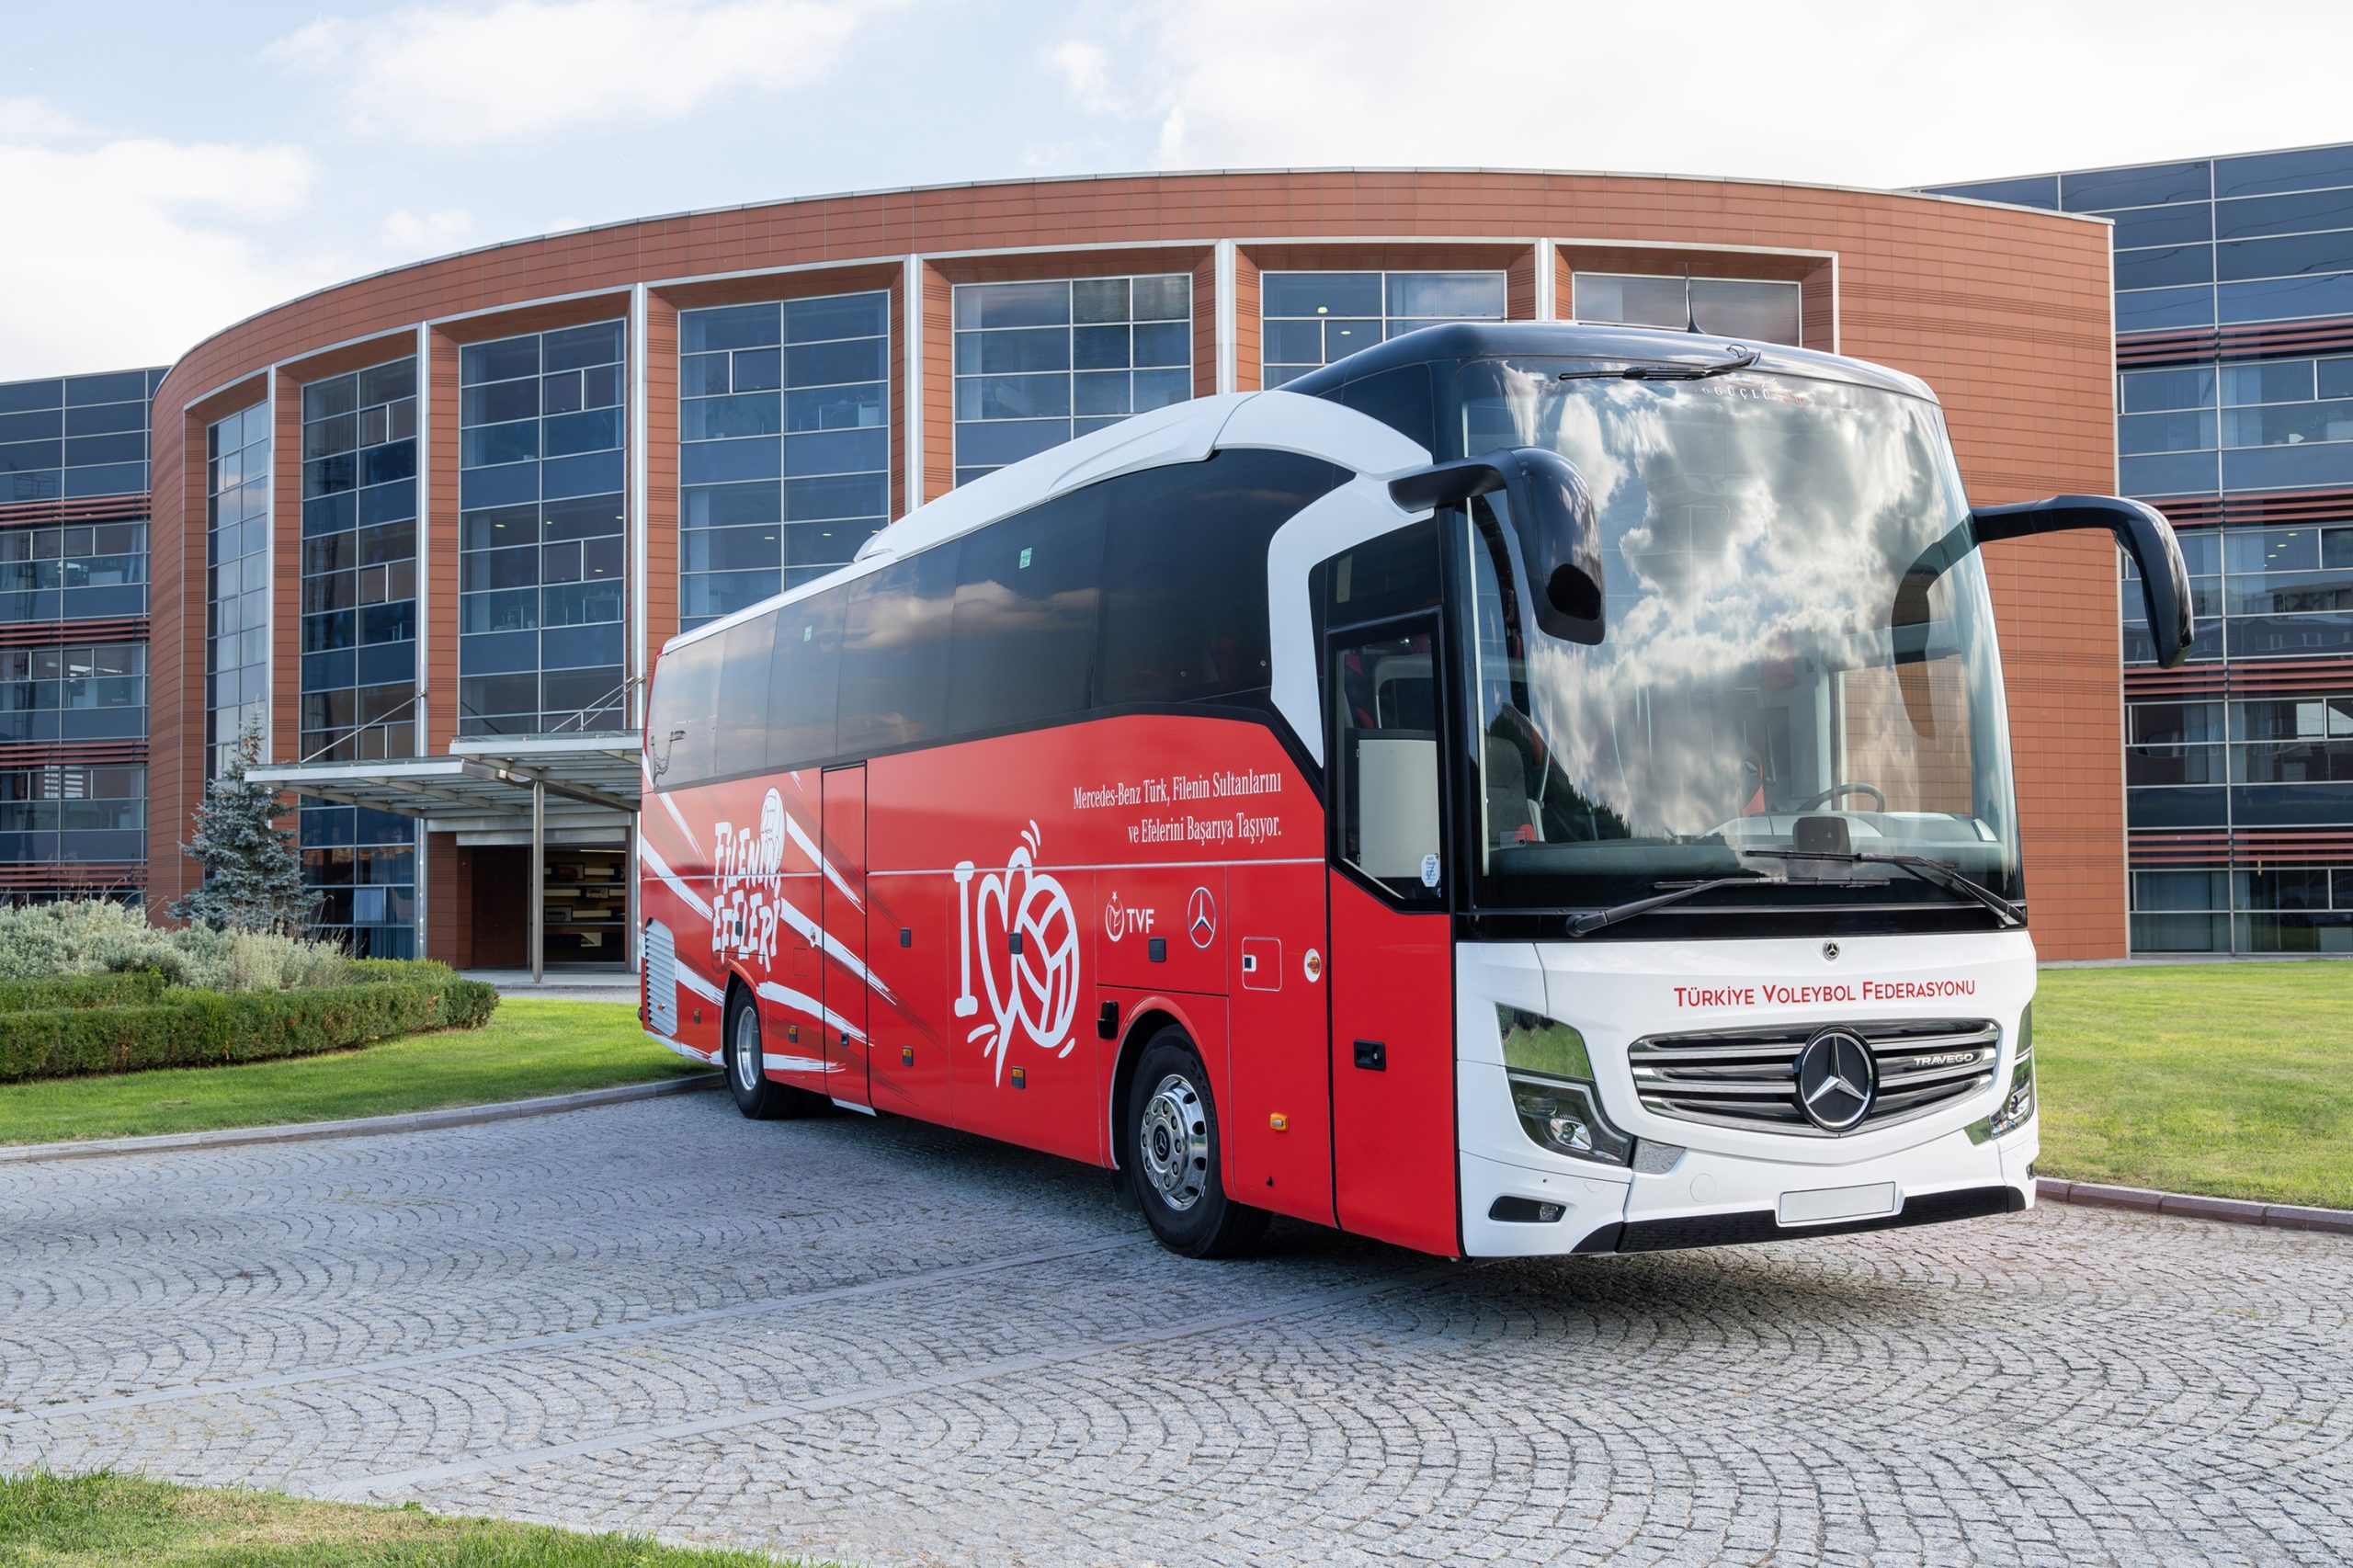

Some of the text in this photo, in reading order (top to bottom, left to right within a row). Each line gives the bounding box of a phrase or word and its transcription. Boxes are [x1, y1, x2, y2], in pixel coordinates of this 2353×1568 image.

[1074, 768, 1281, 809] Mercedes-Benz Türk, Filenin Sultanlarını
[1128, 812, 1281, 846] ve Efelerini Başarıya Taşıyor.
[1126, 908, 1154, 934] TVF
[1674, 980, 1975, 1007] TÜRKİYE VOLEYBOL FEDERASYONU
[1914, 1052, 1974, 1066] TRAVEGO
